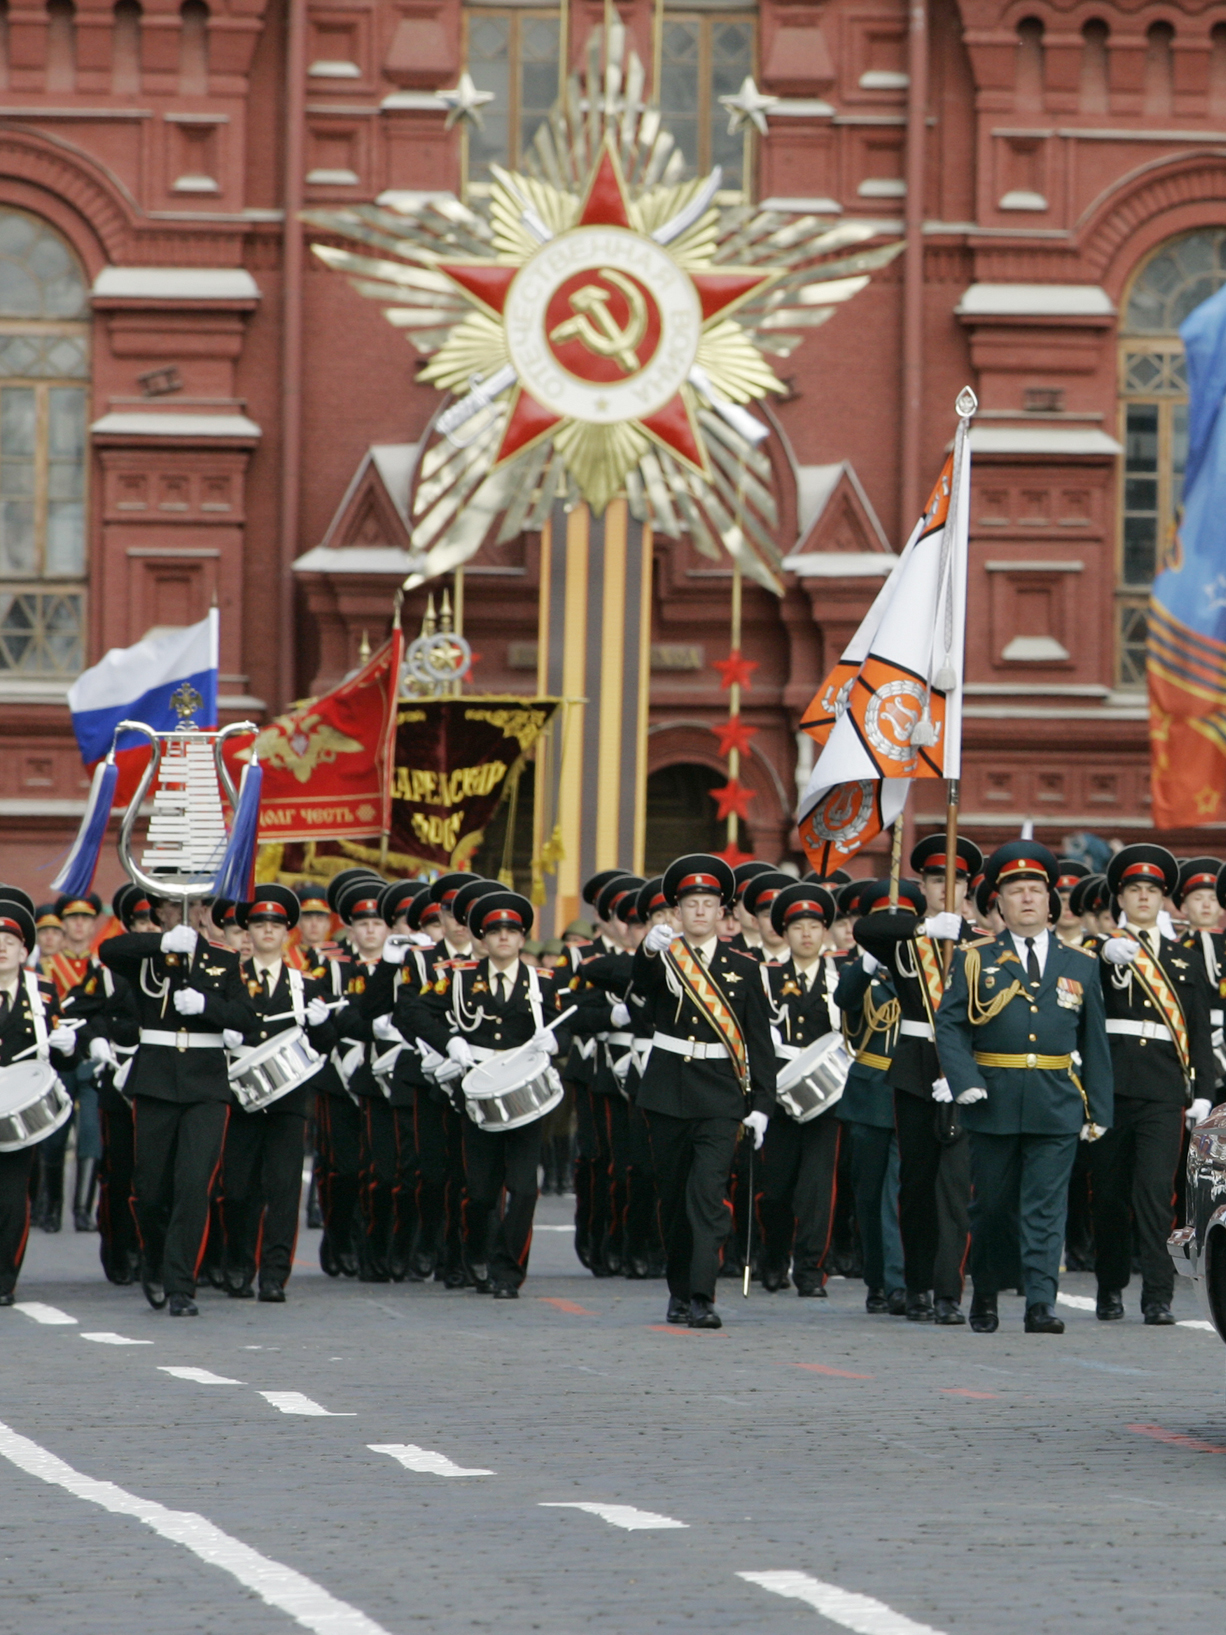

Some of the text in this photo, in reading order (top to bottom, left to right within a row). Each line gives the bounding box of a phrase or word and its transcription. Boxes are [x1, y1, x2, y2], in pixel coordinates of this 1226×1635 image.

[512, 238, 690, 403] ОТЕЧЕСТВЕННАЯ ВОЙНА
[300, 806, 354, 824] ЧЕСТЬ
